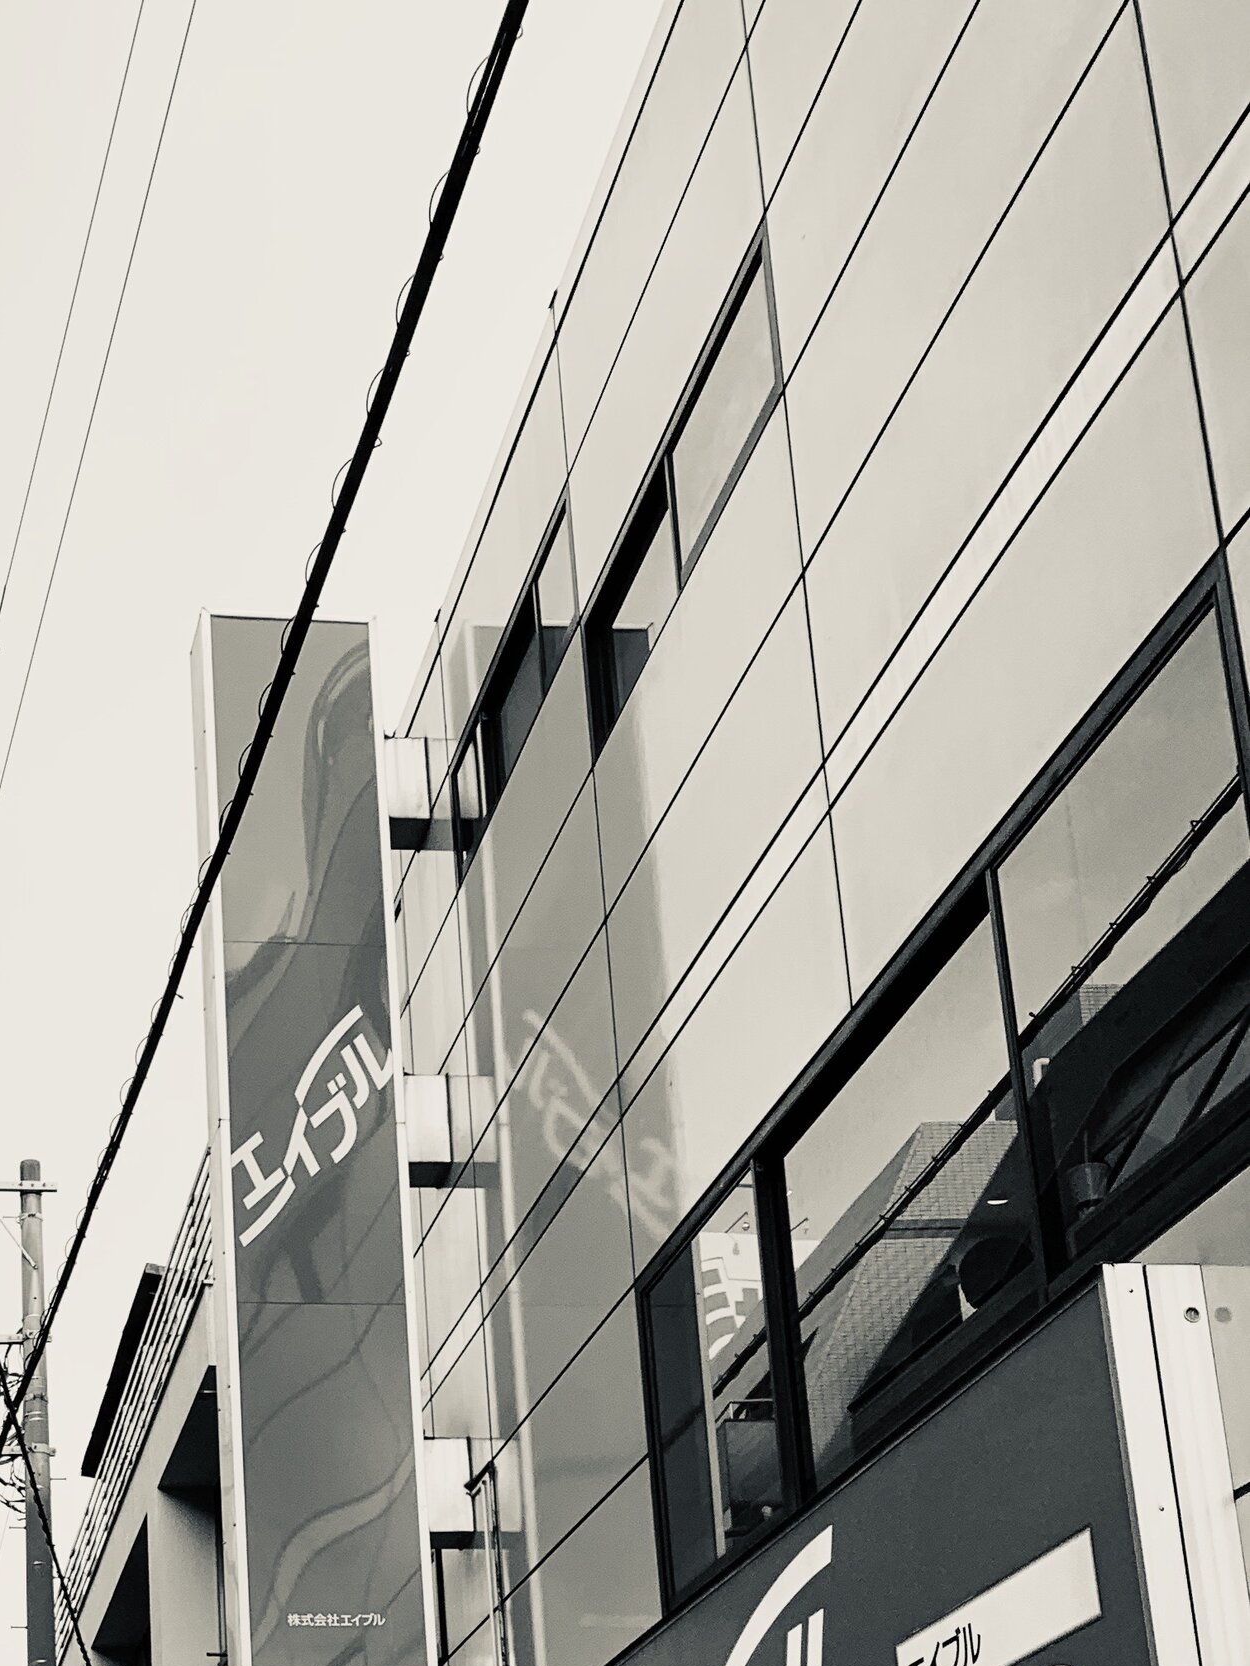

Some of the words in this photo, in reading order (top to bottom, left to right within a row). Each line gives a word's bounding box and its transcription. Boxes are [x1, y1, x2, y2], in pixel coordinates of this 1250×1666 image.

[230, 1005, 393, 1247] エイブル
[287, 1613, 386, 1626] 株式会社エイブル
